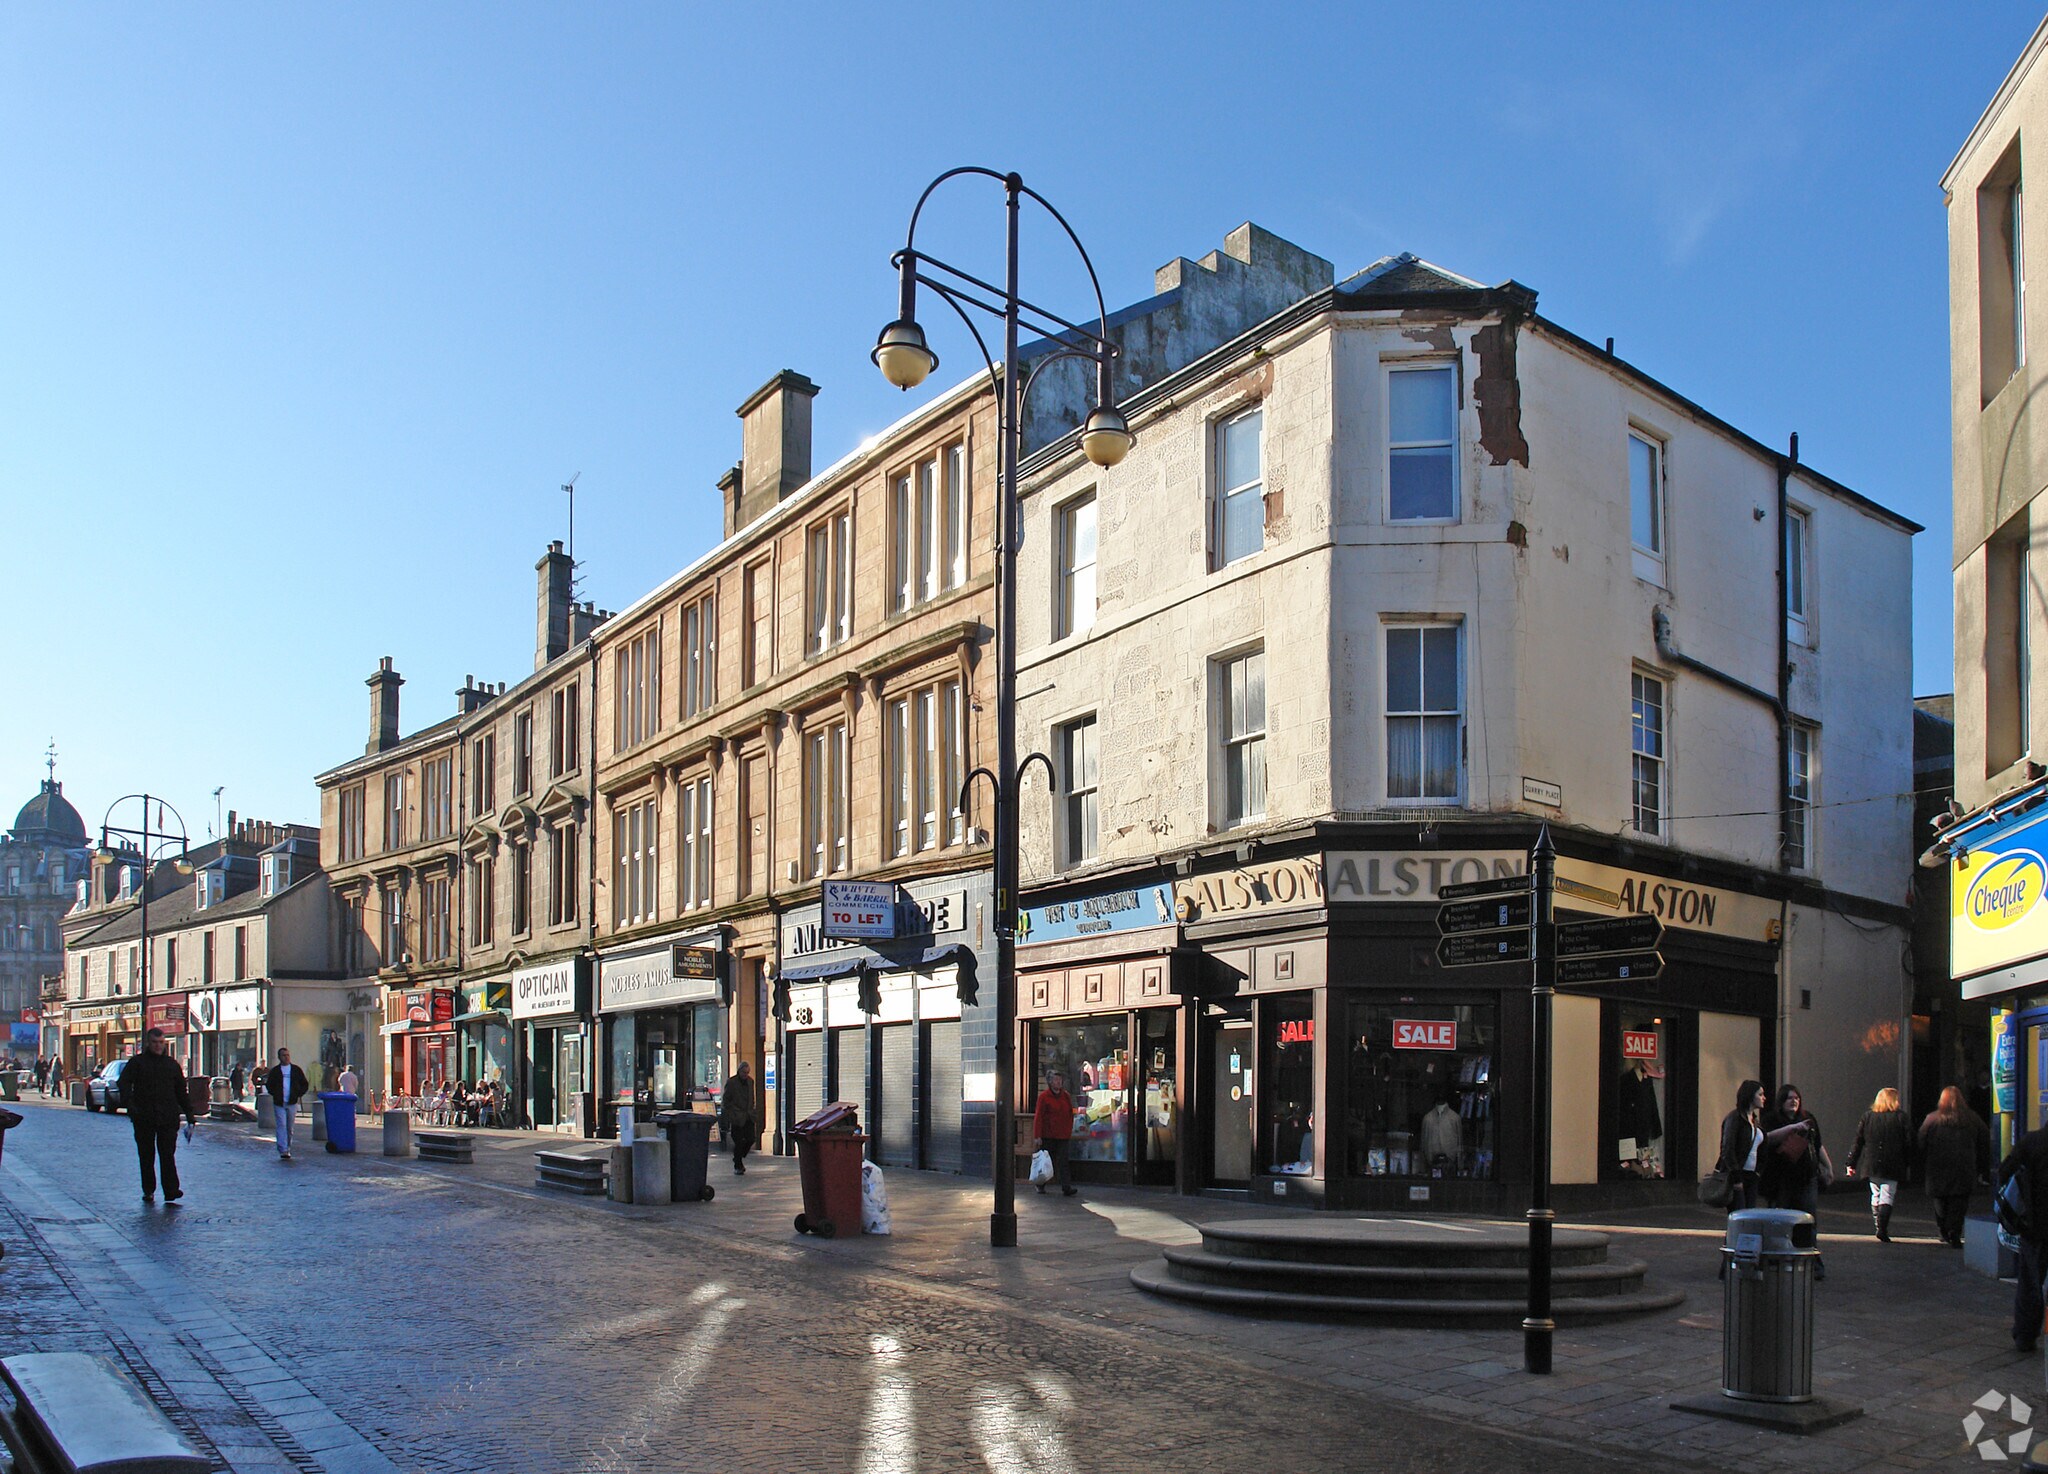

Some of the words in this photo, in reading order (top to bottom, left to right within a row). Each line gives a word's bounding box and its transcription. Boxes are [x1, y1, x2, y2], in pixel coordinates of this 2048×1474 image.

[1546, 790, 1560, 800] PLACE
[1332, 857, 1522, 897] ALSTON
[841, 885, 877, 894] WHYTE
[1196, 864, 1321, 913] ALSTON
[828, 902, 889, 910] COMMERCIAL
[843, 893, 851, 901] &
[853, 894, 889, 904] BARRIE
[1044, 905, 1065, 924] PET
[1068, 902, 1079, 920] &
[1083, 889, 1140, 919] AQUARIUM
[1619, 878, 1717, 926] ALSTON
[1974, 879, 2026, 918] Cheque
[832, 913, 852, 924] TO
[858, 914, 884, 925] LET
[2006, 904, 2025, 918] centre
[678, 961, 712, 969] AMUSEMENTS
[519, 970, 568, 999] OPTICIAN
[609, 973, 641, 993] NOBLES
[407, 995, 419, 1005] AGFA
[1398, 1024, 1452, 1045] SALE
[1625, 1036, 1655, 1054] SALE
